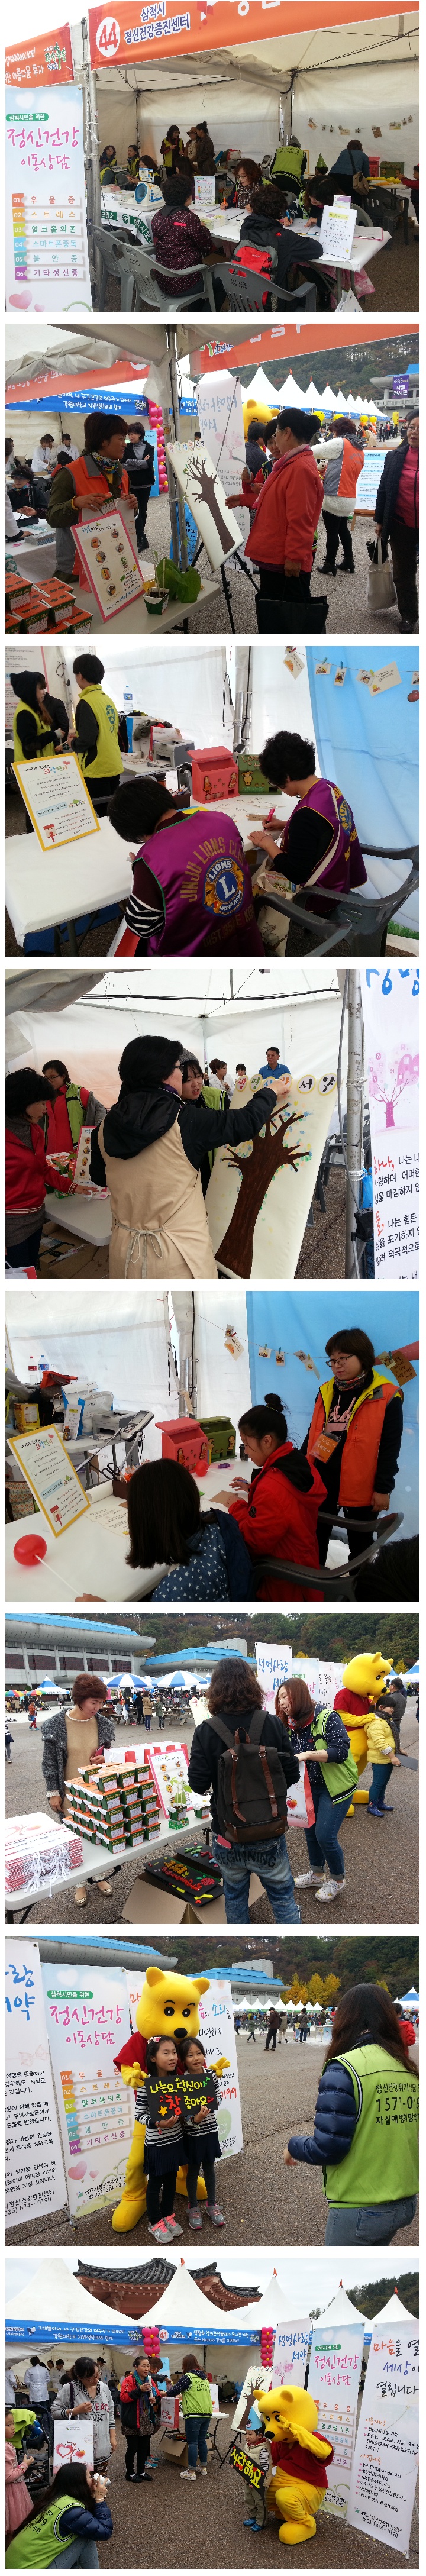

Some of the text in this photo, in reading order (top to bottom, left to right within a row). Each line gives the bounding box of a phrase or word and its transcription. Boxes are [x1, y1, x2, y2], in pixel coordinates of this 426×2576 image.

[141, 2, 166, 22] 삼척시
[99, 22, 118, 50] 44
[124, 12, 190, 44] 정신건강증진센터
[12, 64, 44, 82] 아름다운 투자
[7, 127, 79, 148] 정신건강
[21, 154, 70, 171] 이동상담
[33, 240, 77, 248] 스마트폰중독
[34, 269, 79, 277] 기타정신증
[43, 764, 68, 774] 희망편지
[180, 837, 226, 902] JINJU LIONS
[208, 860, 232, 880] LIONS
[218, 876, 235, 899] L
[299, 1076, 335, 1093] 서약
[373, 1155, 412, 1175] 하나, 나는
[374, 1172, 396, 1189] 사랑하며
[386, 1183, 413, 1199] 마감하지
[376, 1210, 417, 1237] 둘, 나는 힘든
[388, 1228, 415, 1244] 포기하지
[376, 1241, 419, 1267] 알려 적극적으로
[258, 1657, 289, 1673] 생명사랑
[49, 2004, 124, 2026] 정신건강
[66, 2031, 115, 2048] 이동상담
[150, 2080, 202, 2094] 나는요, 당신이
[81, 2093, 122, 2107] 알코올의존
[165, 2094, 208, 2116] 참 좋아요
[83, 2106, 123, 2120] 스마트폰중독
[6, 2116, 51, 2129] 도움을 받겠습니다.
[86, 2130, 125, 2146] 기타정신증
[15, 2166, 31, 2175] 위기를
[33, 2161, 49, 2170] 인생의
[25, 2167, 57, 2180] 어떠한 위기의
[34, 2175, 56, 2186] 것입니다.
[37, 2196, 52, 2205] 0190
[278, 2332, 309, 2348] 생명사랑
[373, 2339, 402, 2357] 마음을
[292, 2348, 307, 2366] 서약
[314, 2354, 360, 2370] 정신건강
[383, 2361, 419, 2375] 세상이
[320, 2373, 351, 2386] 이동상담
[376, 2381, 419, 2398] 열립니다
[230, 2448, 262, 2490] 사랑해요
[387, 2529, 398, 2538] 0190
